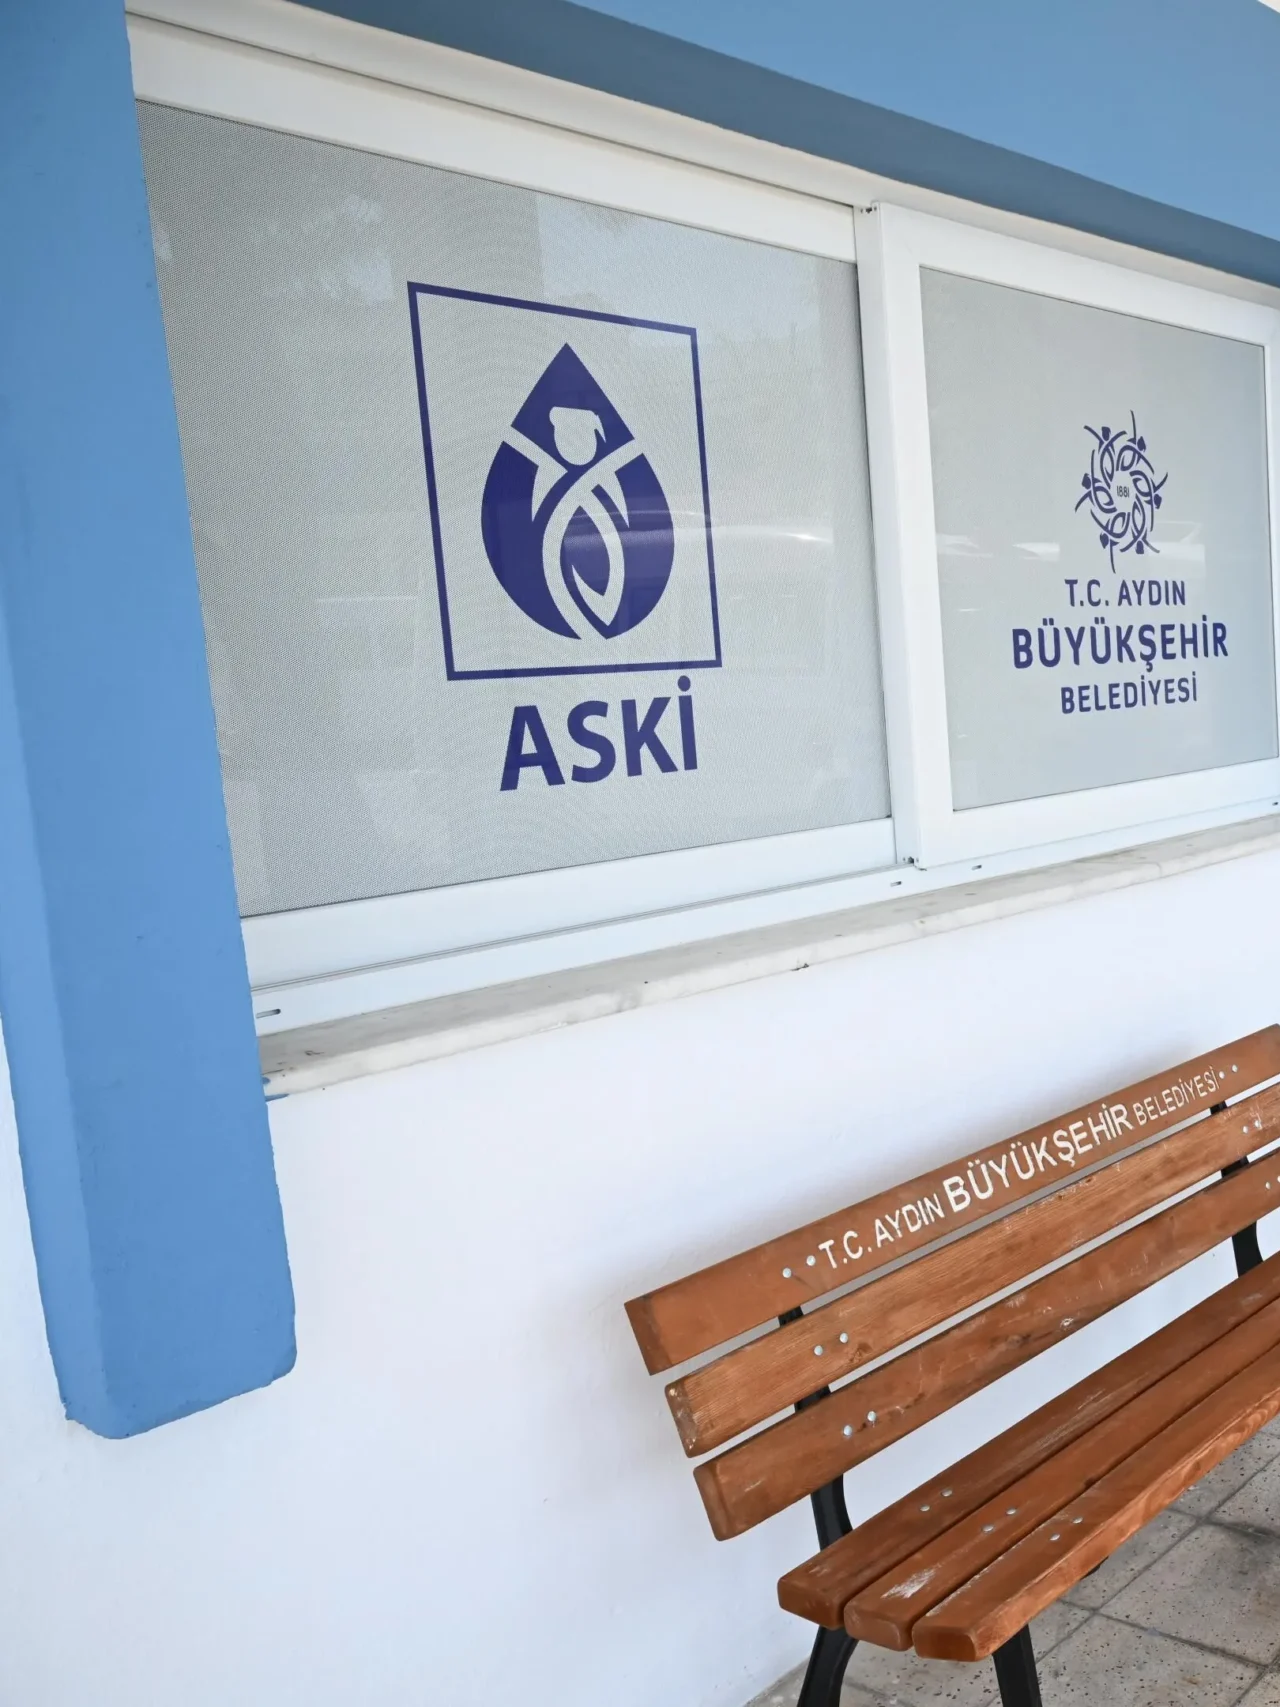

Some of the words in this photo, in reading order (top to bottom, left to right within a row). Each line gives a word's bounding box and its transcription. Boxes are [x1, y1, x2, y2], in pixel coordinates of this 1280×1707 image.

[1117, 485, 1130, 498] 1881
[1064, 579, 1110, 607] T.C.
[1117, 579, 1186, 606] AYDIN
[1012, 614, 1229, 672] BÜYÜKŞEHİR
[1060, 671, 1198, 714] BELEDİYESİ
[500, 675, 698, 791] ASKİ
[819, 1230, 873, 1269] T.C.
[874, 1192, 945, 1248] AYDIN
[942, 1101, 1134, 1213] BÜYÜKŞEHİR
[1132, 1065, 1221, 1126] BELEDİYESİ
